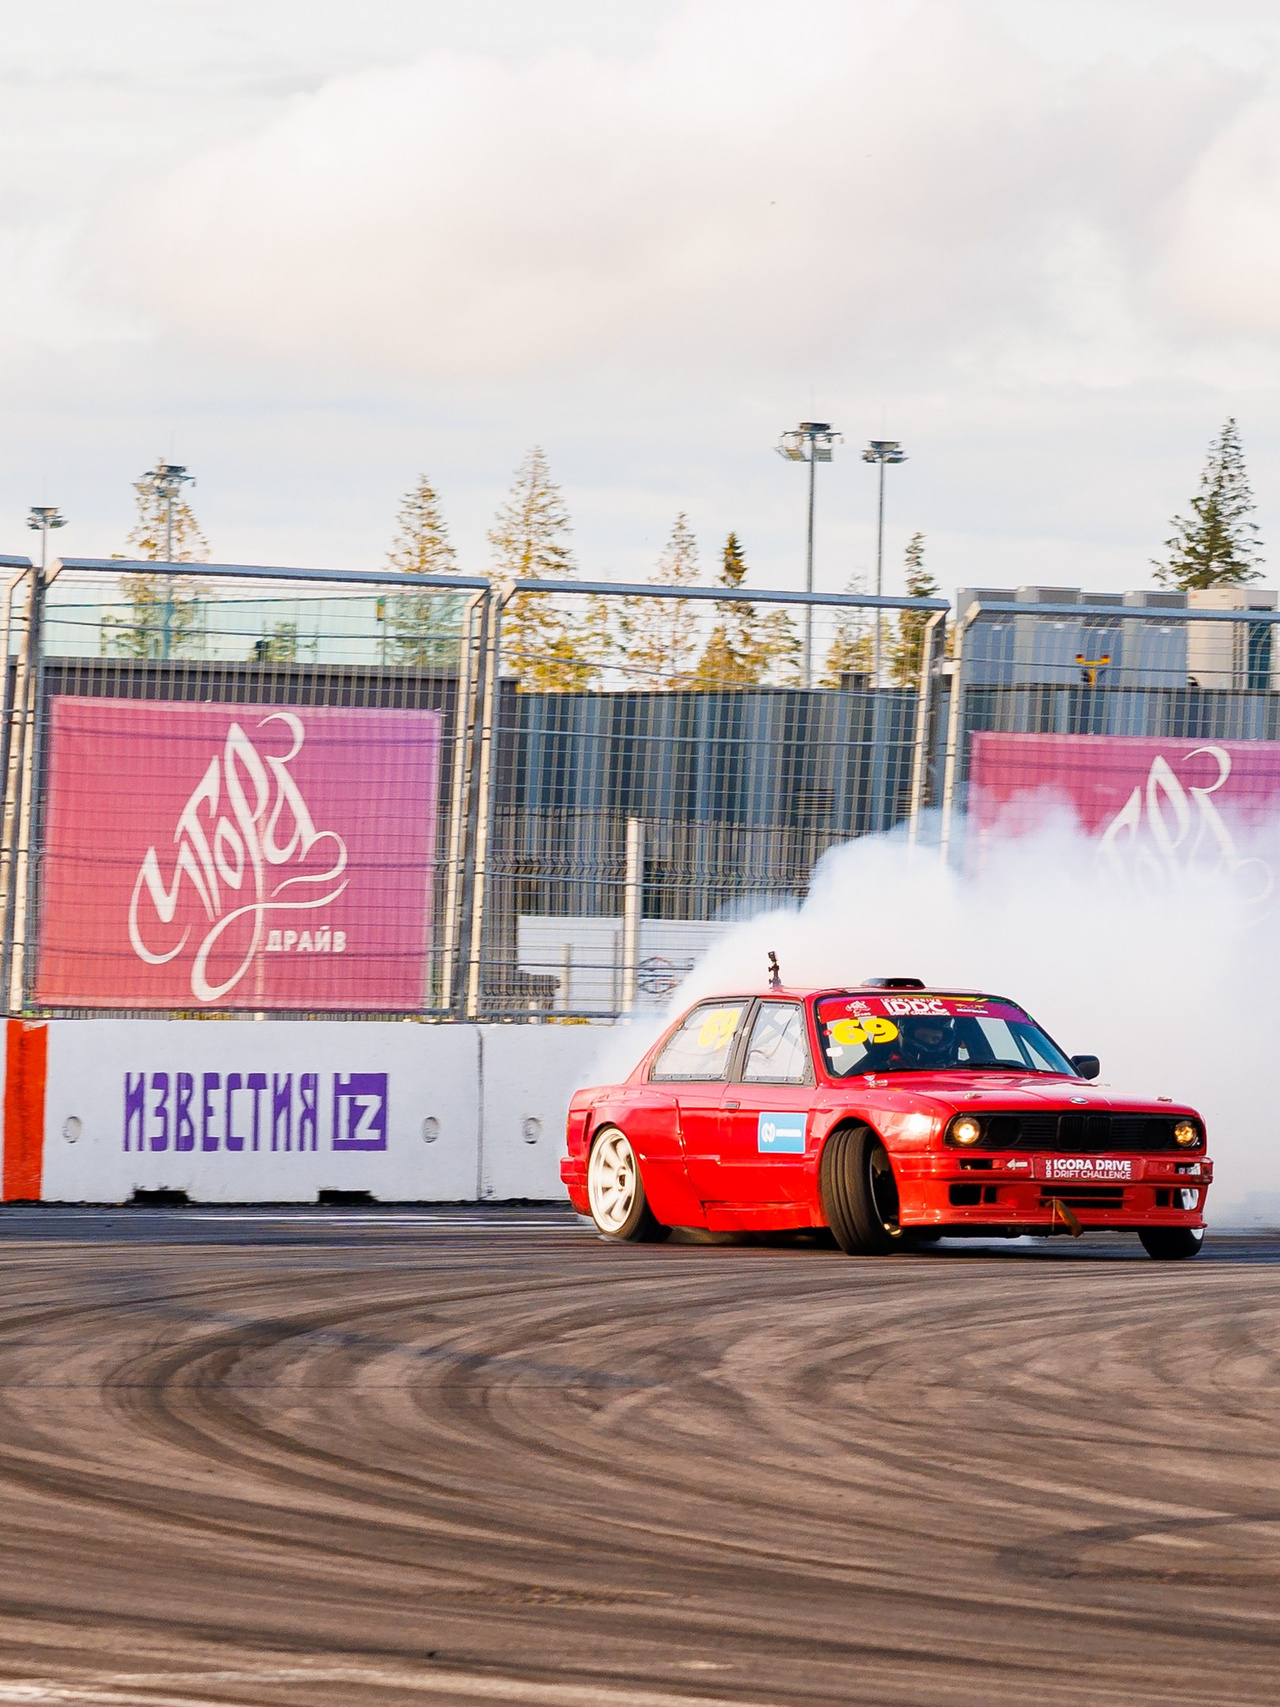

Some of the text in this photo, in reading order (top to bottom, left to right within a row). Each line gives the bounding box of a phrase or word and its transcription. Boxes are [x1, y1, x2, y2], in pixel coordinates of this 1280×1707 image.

[264, 925, 347, 952] ДРАЙВ
[881, 999, 948, 1015] IDDC
[698, 1008, 739, 1049] 69
[832, 1018, 899, 1045] 69
[123, 1072, 318, 1151] ИЗВЕСТИЯ
[1053, 1159, 1132, 1171] IGORA DRIVE
[1053, 1170, 1132, 1179] DRIFT CHALLENGE
